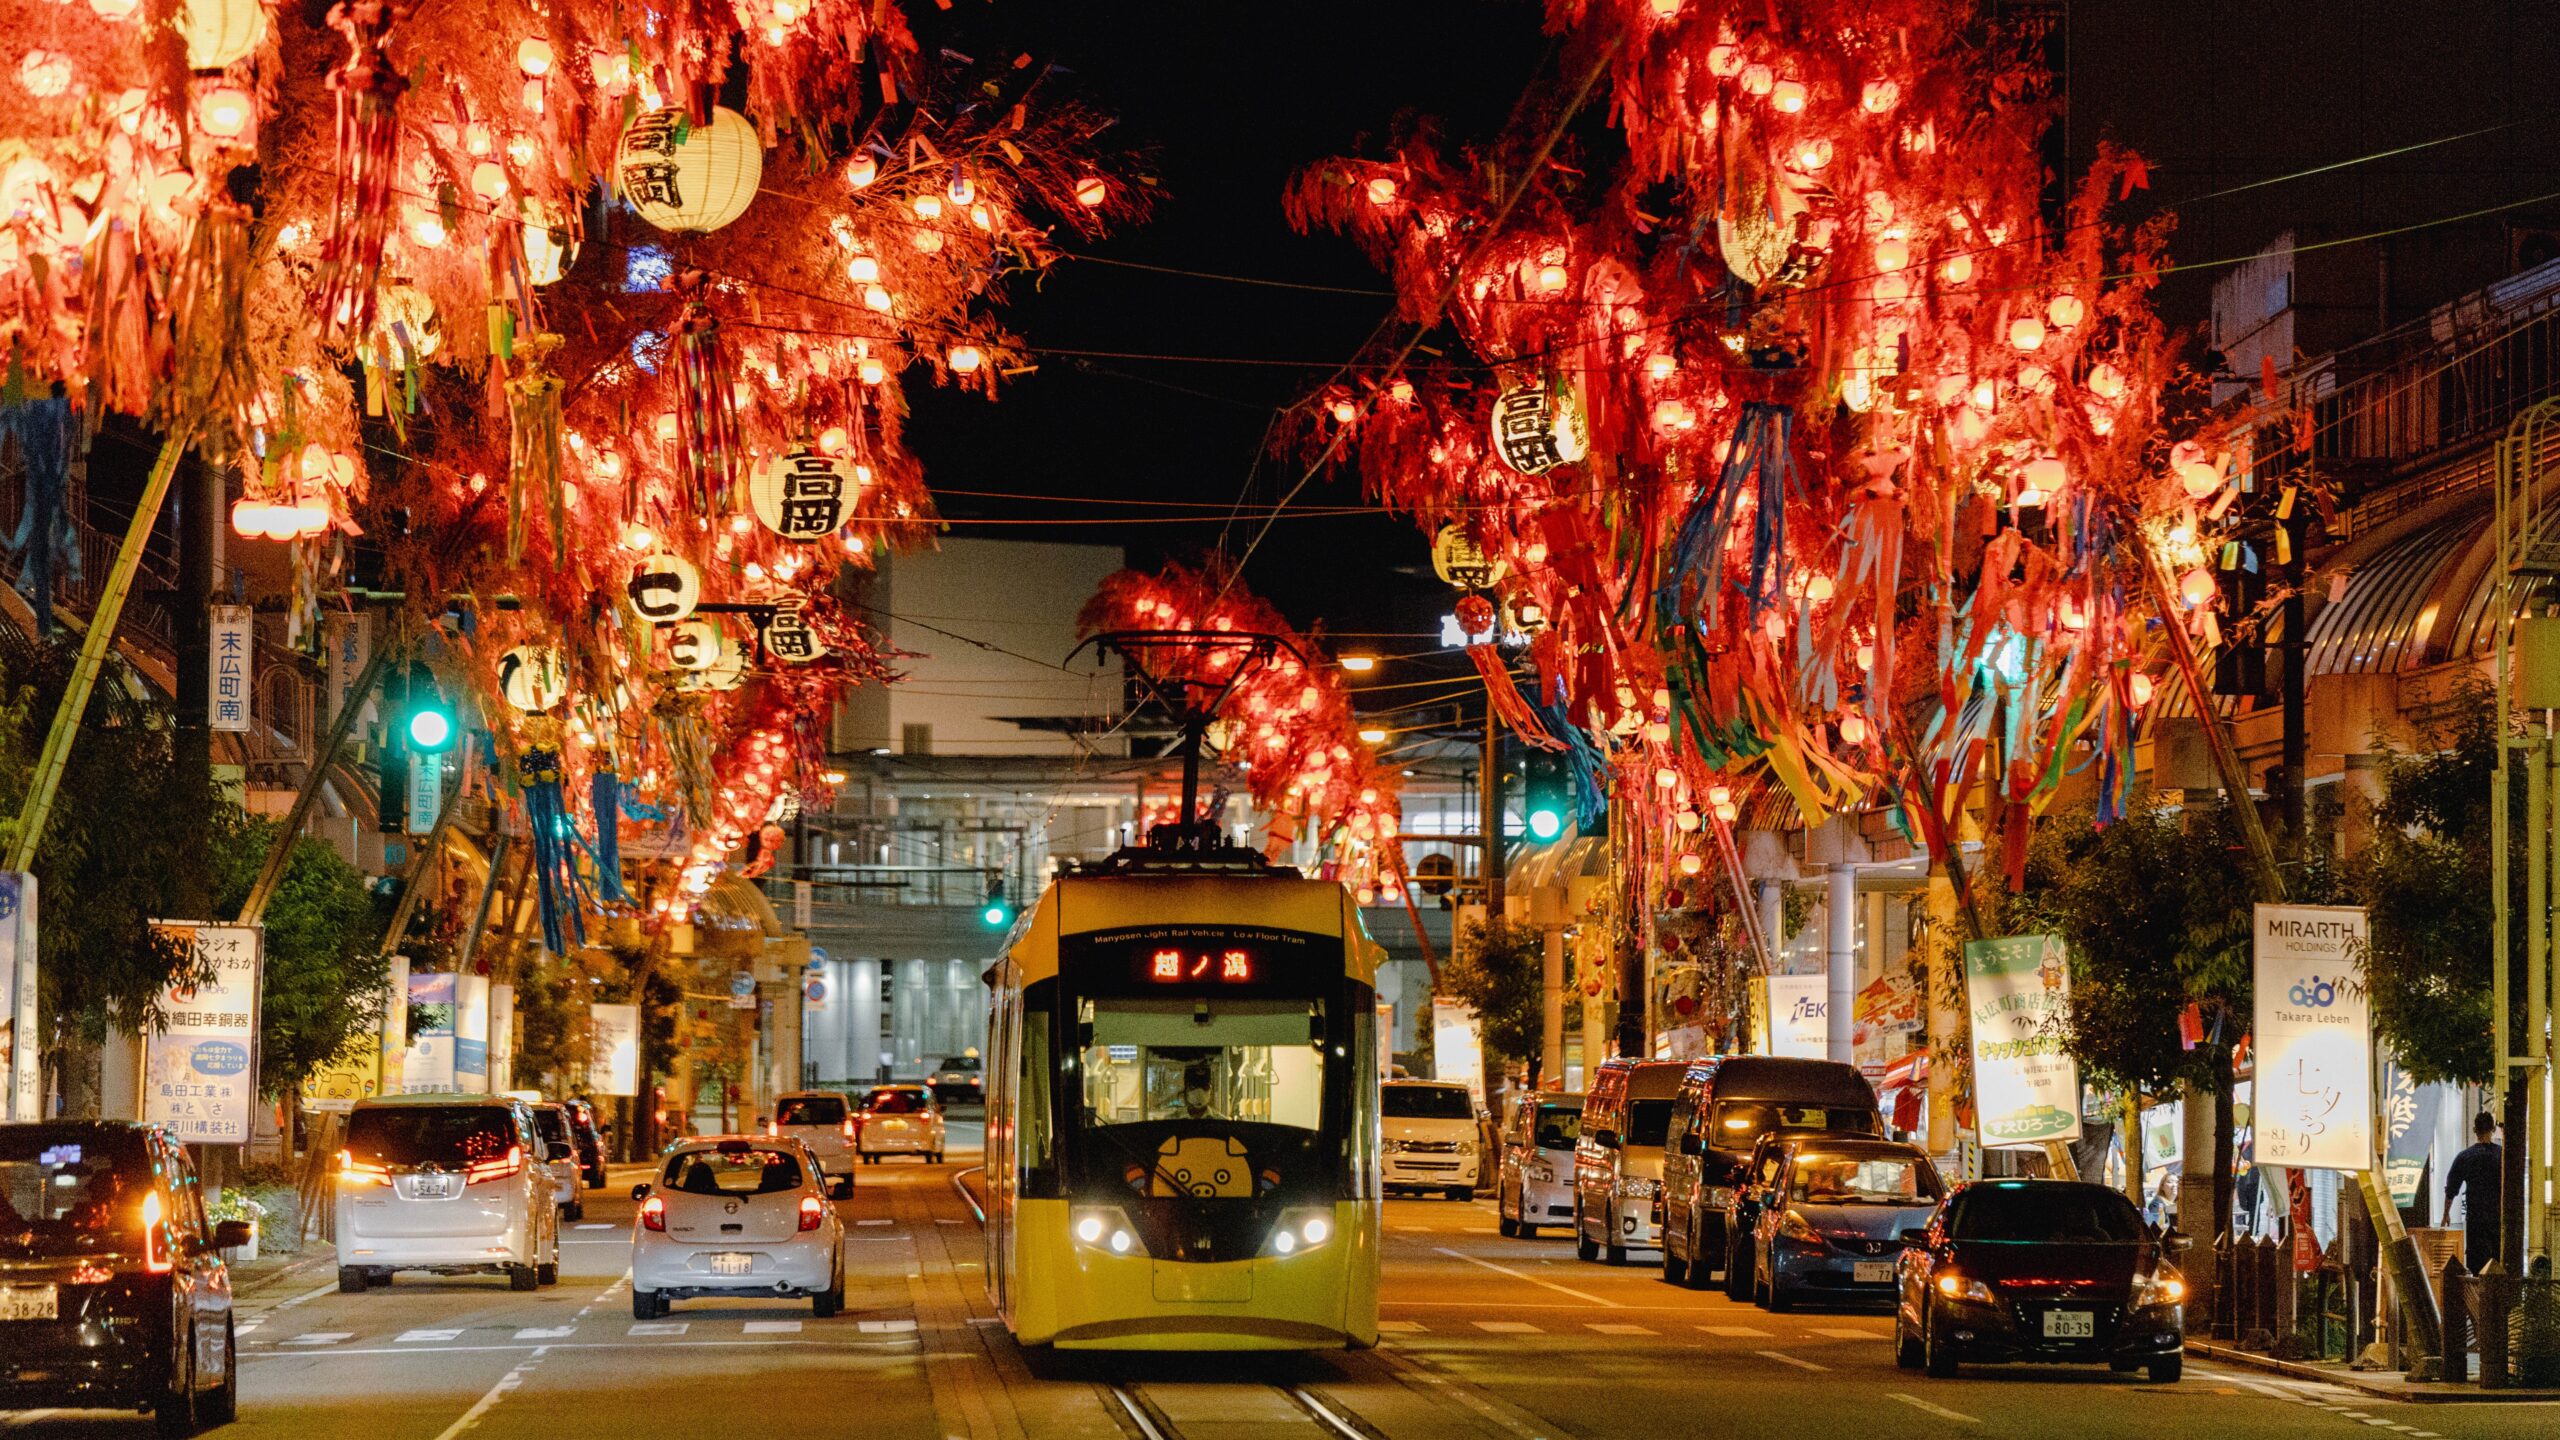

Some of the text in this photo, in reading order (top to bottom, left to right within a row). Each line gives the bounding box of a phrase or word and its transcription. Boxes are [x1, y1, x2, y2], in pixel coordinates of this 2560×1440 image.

[1501, 376, 1564, 476] 高岡
[778, 447, 843, 534] 高岡
[1094, 932, 1142, 944] Manyosen
[1171, 929, 1189, 937] Rail
[1256, 932, 1280, 941] Floor
[1282, 934, 1306, 945] Tram
[2268, 919, 2354, 940] MIRARTH
[199, 938, 241, 952] ラジオ
[2286, 941, 2338, 953] HOLDINGS
[201, 957, 254, 970] かおか
[1154, 951, 1247, 977] 越ノ潟
[2275, 1011, 2350, 1025] Takara Leben
[12, 1302, 54, 1318] 38-28
[2055, 1322, 2092, 1336] 80-39
